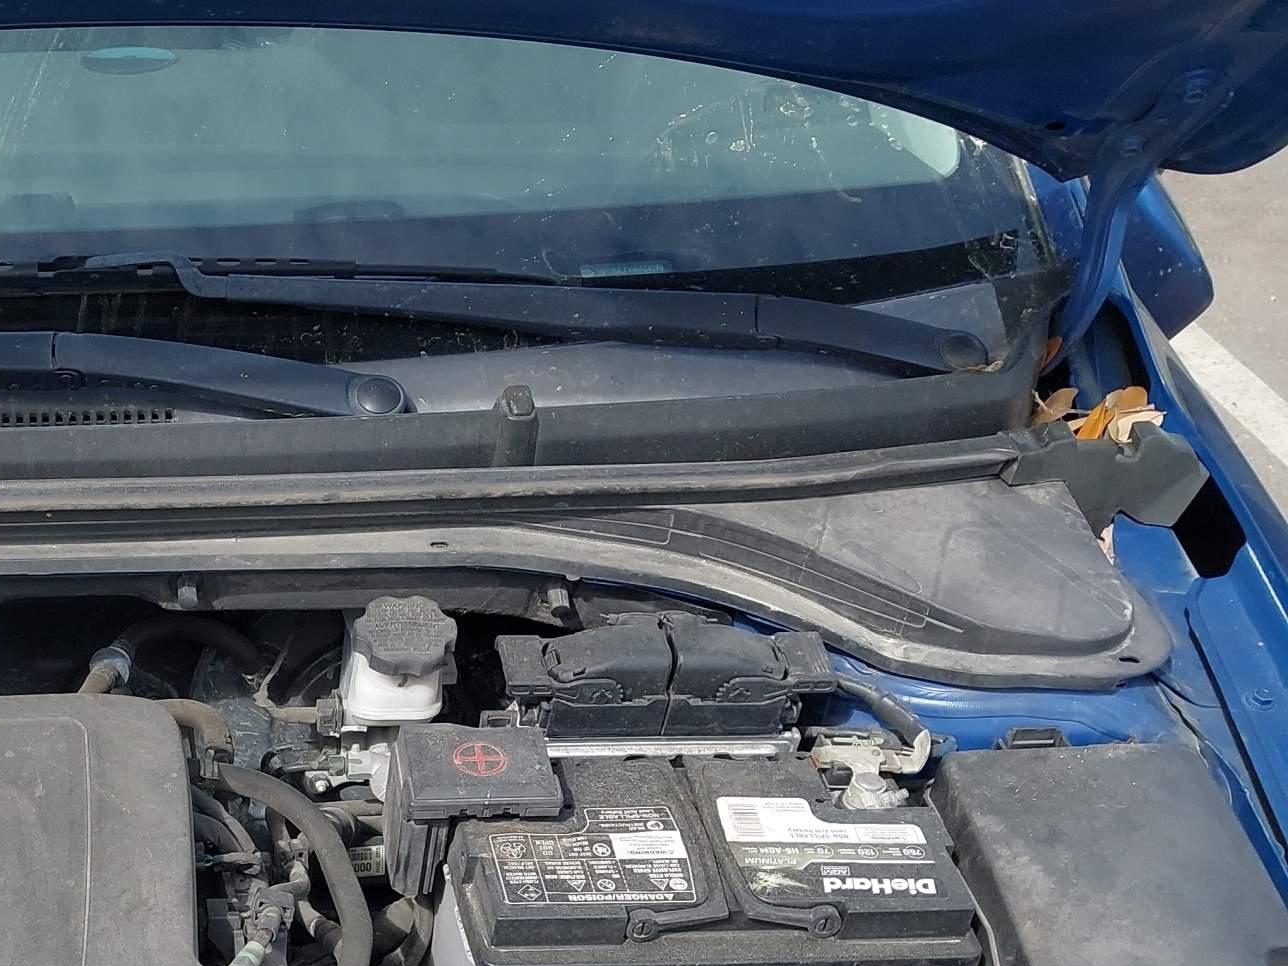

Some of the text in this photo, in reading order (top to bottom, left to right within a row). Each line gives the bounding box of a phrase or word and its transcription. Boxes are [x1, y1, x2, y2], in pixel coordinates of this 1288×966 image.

[816, 847, 831, 855] 70
[857, 848, 875, 856] 120
[744, 857, 797, 865] PLATINUM
[822, 877, 936, 895] DieHard
[567, 893, 665, 901] DANGER/POISON
